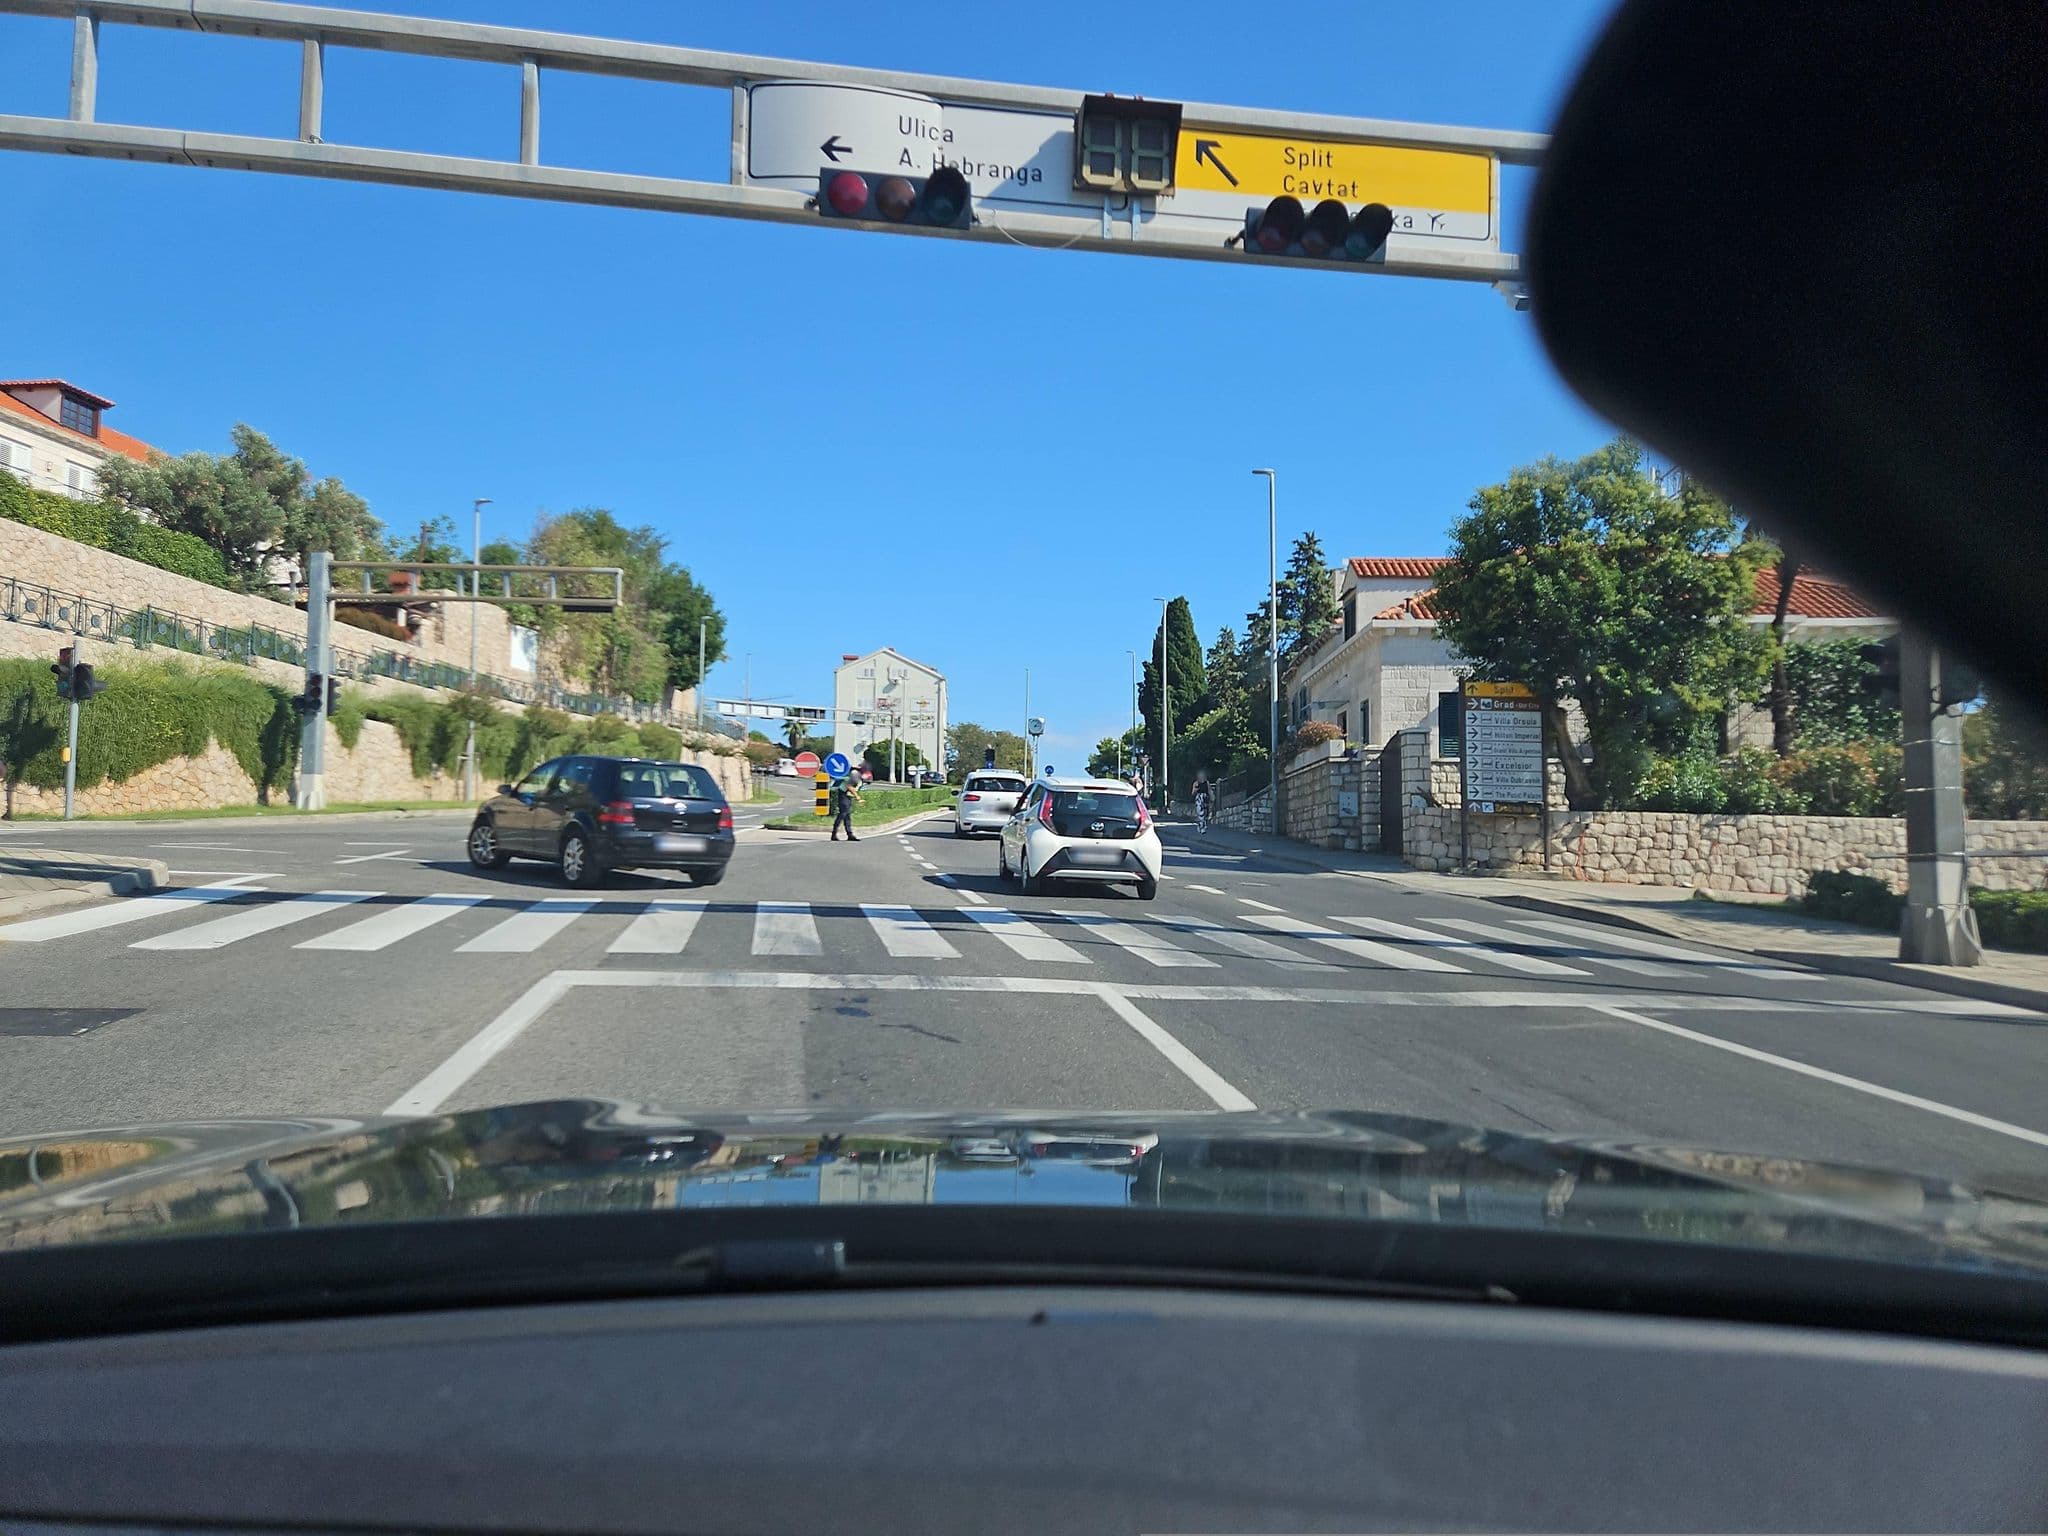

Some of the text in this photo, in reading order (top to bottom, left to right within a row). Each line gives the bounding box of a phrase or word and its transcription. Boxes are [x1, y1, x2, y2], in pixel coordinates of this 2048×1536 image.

[899, 114, 955, 143] Ulica
[899, 147, 921, 169] A.
[1283, 146, 1333, 170] Split
[1283, 175, 1359, 199] Cavtat
[1494, 700, 1514, 708] Grad
[1494, 716, 1510, 724] Villa
[1495, 761, 1532, 769] Excelsior
